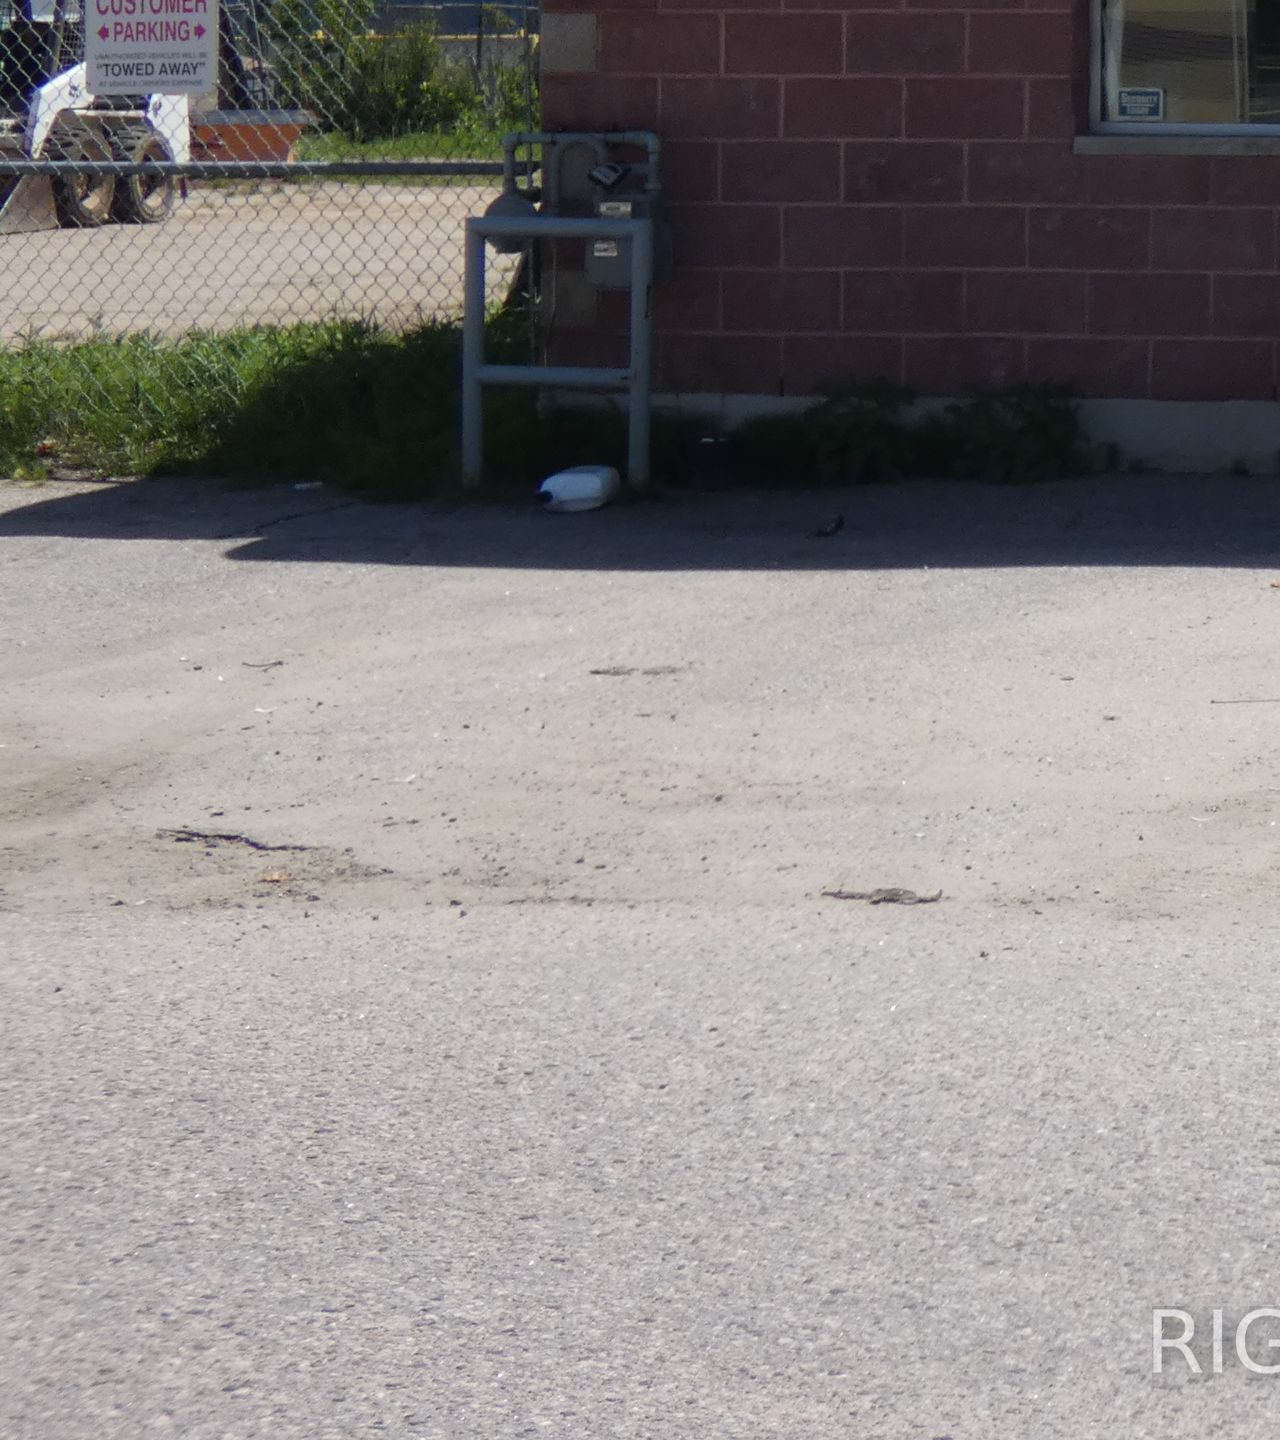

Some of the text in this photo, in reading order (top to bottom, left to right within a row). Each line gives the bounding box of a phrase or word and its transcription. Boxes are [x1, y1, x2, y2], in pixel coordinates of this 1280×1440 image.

[113, 20, 191, 43] PARKING
[96, 62, 206, 77] "TOWED AWAY"
